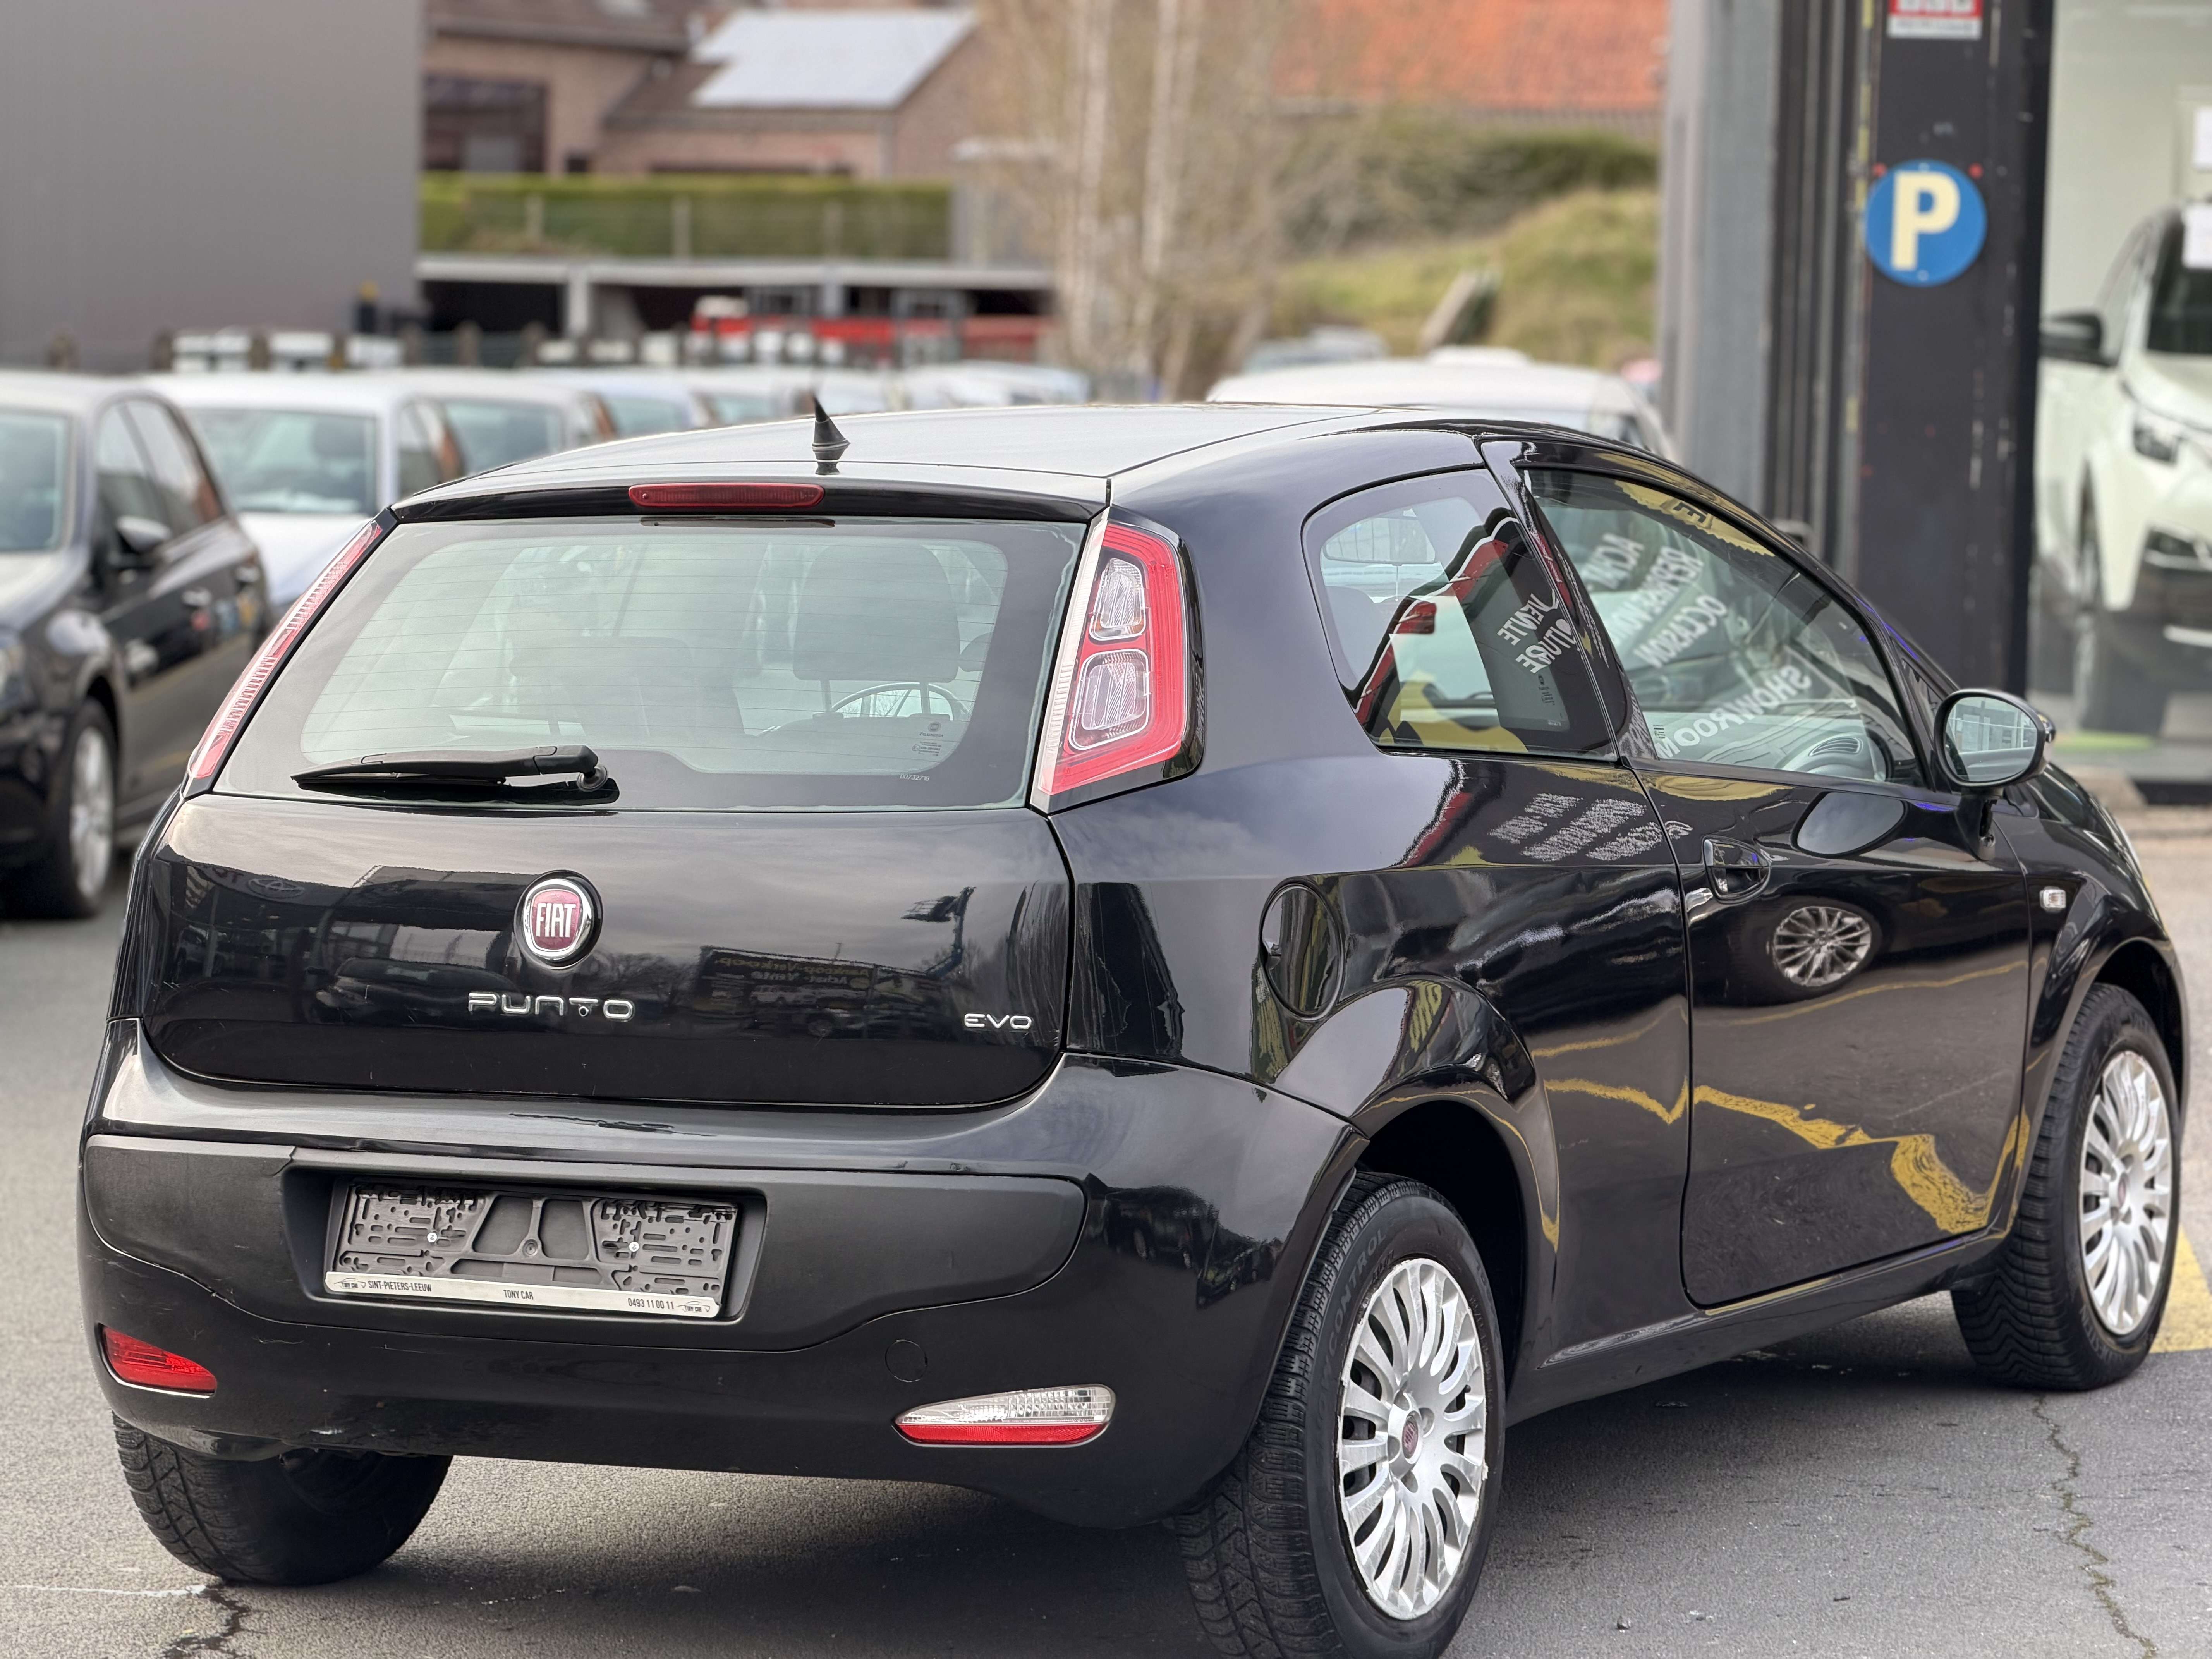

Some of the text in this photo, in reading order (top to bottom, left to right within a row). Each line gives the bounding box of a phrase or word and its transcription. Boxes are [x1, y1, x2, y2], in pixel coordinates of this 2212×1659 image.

[1891, 171, 1960, 271] P
[536, 903, 577, 938] FIAT
[468, 992, 634, 1022] PUNTO
[964, 1013, 1032, 1030] EVO
[368, 1280, 432, 1291] SINT-PIETERS-LEEUW
[503, 1289, 534, 1300] TONY CAR
[628, 1297, 674, 1310] 0493 11 00 11
